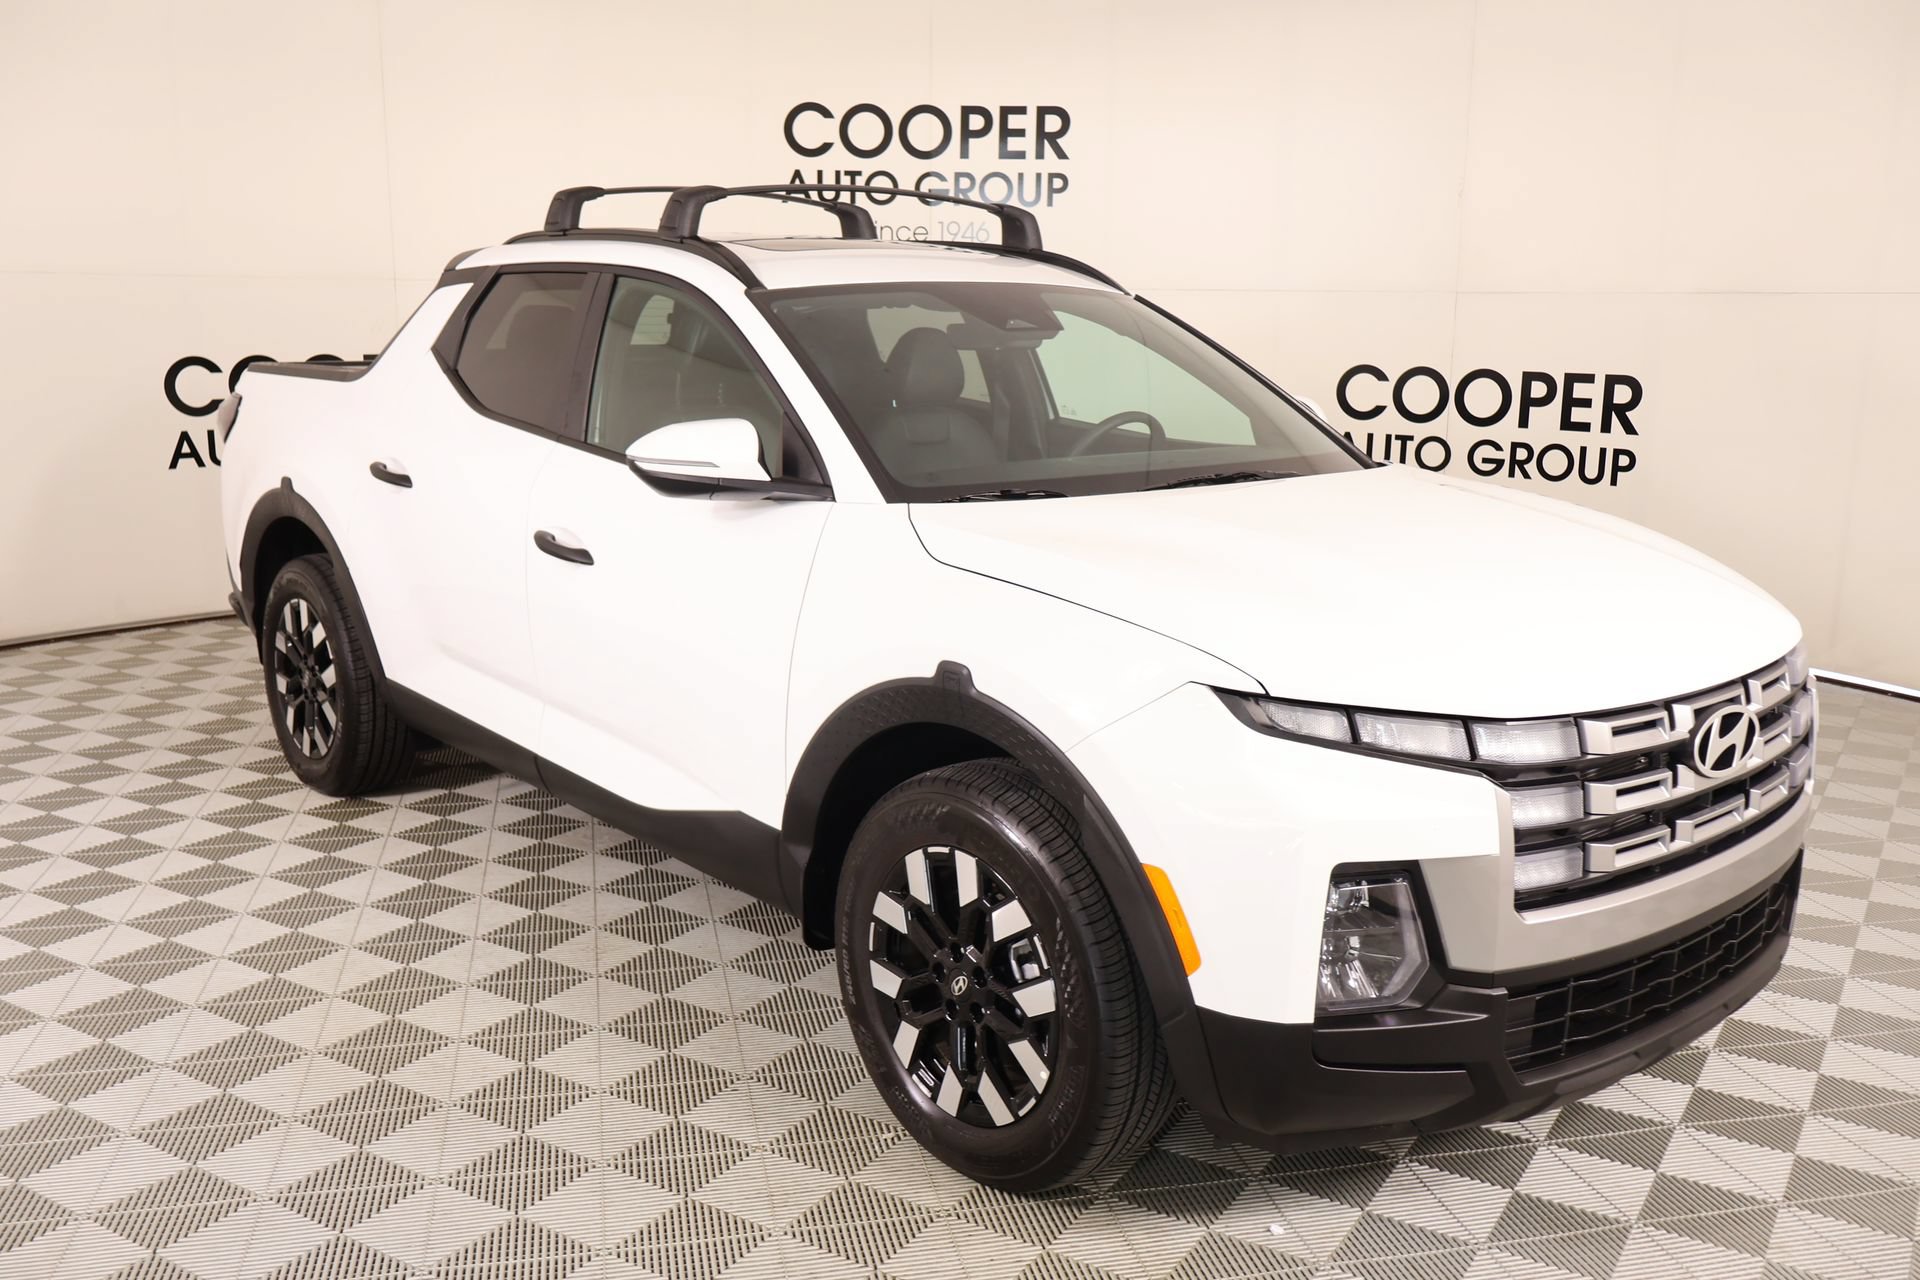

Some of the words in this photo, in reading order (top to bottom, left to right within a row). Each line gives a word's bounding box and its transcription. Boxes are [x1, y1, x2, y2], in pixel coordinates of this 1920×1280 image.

[784, 101, 1071, 160] COOPER
[782, 169, 899, 206] AUTO
[914, 170, 1069, 207] GROUP
[937, 220, 990, 243] 1946
[1336, 364, 1644, 436] COOPER
[1467, 439, 1637, 487] GROUP
